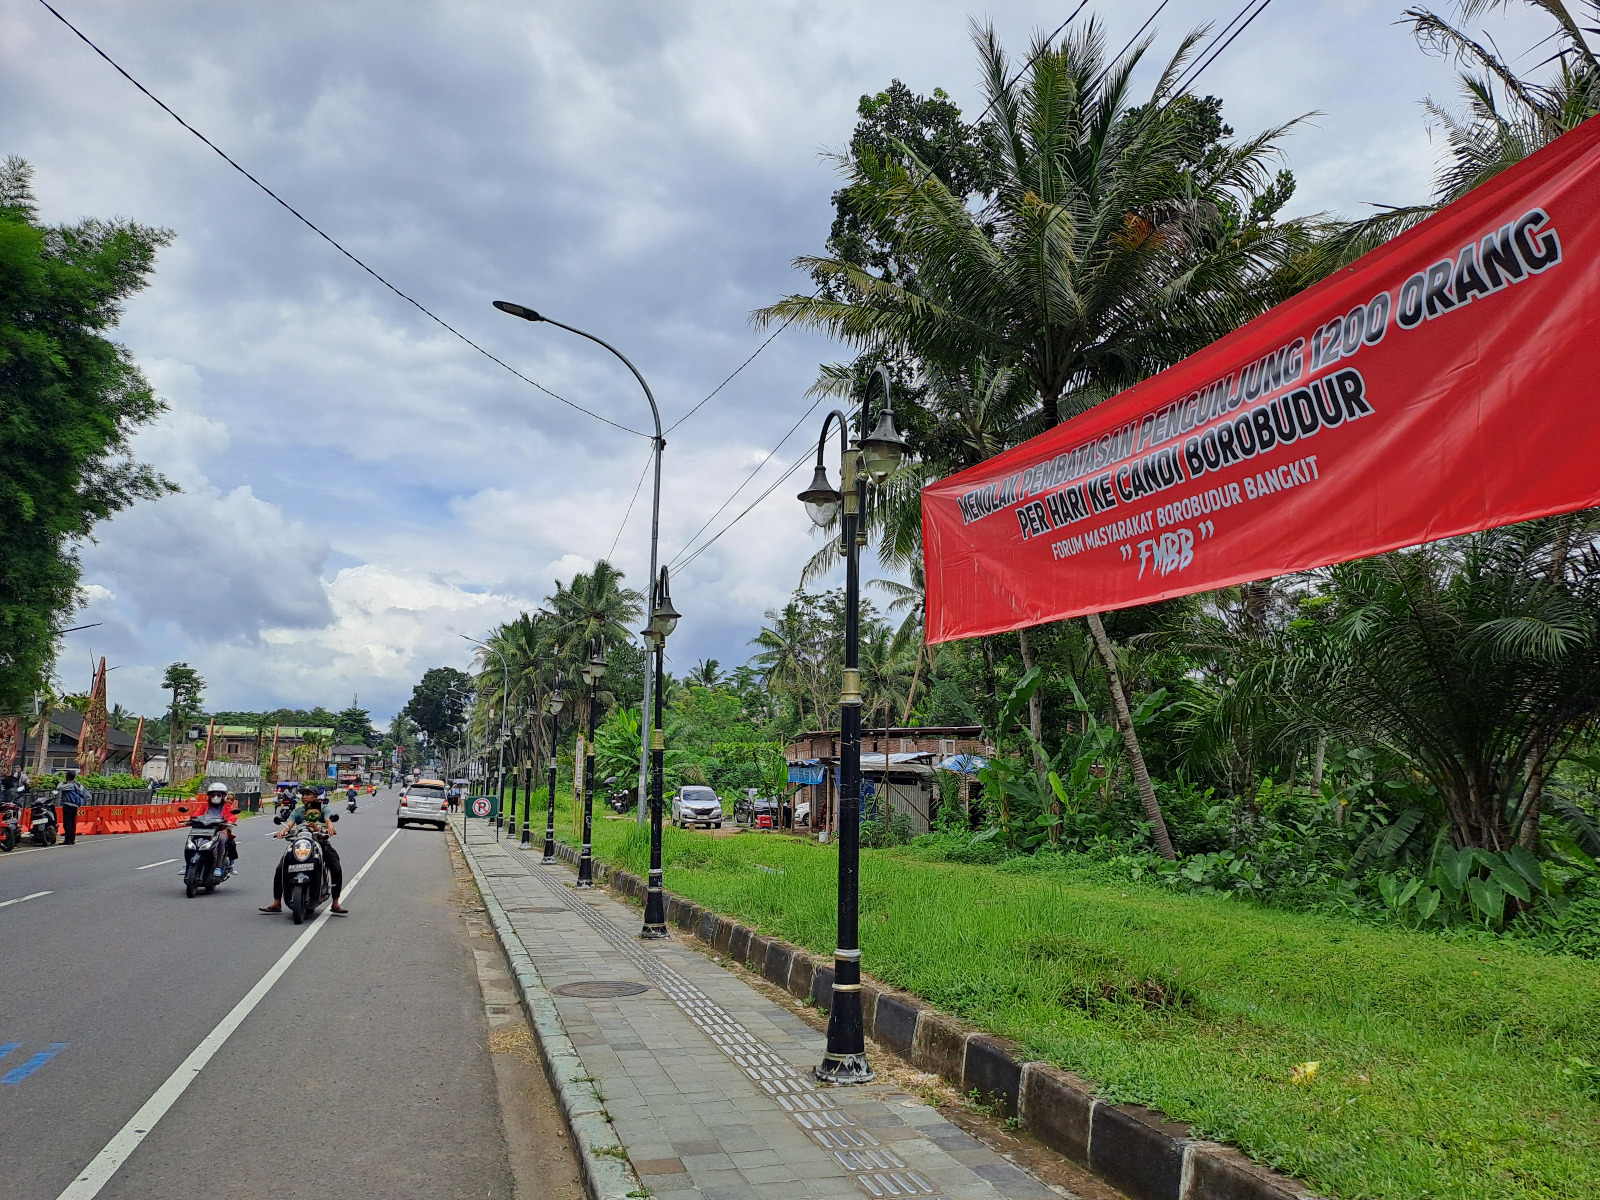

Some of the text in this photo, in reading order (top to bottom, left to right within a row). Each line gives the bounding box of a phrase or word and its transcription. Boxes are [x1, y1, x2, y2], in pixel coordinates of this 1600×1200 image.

[957, 207, 1563, 526] MENOLAK PEMBATASAN PENGUNJUNG 1200 ORANG
[1015, 367, 1376, 541] PER HARI KE CANDI BOROBUDUR
[1051, 455, 1320, 560] FORUM MASYARAKAT BOROBUDUR BANGKIT
